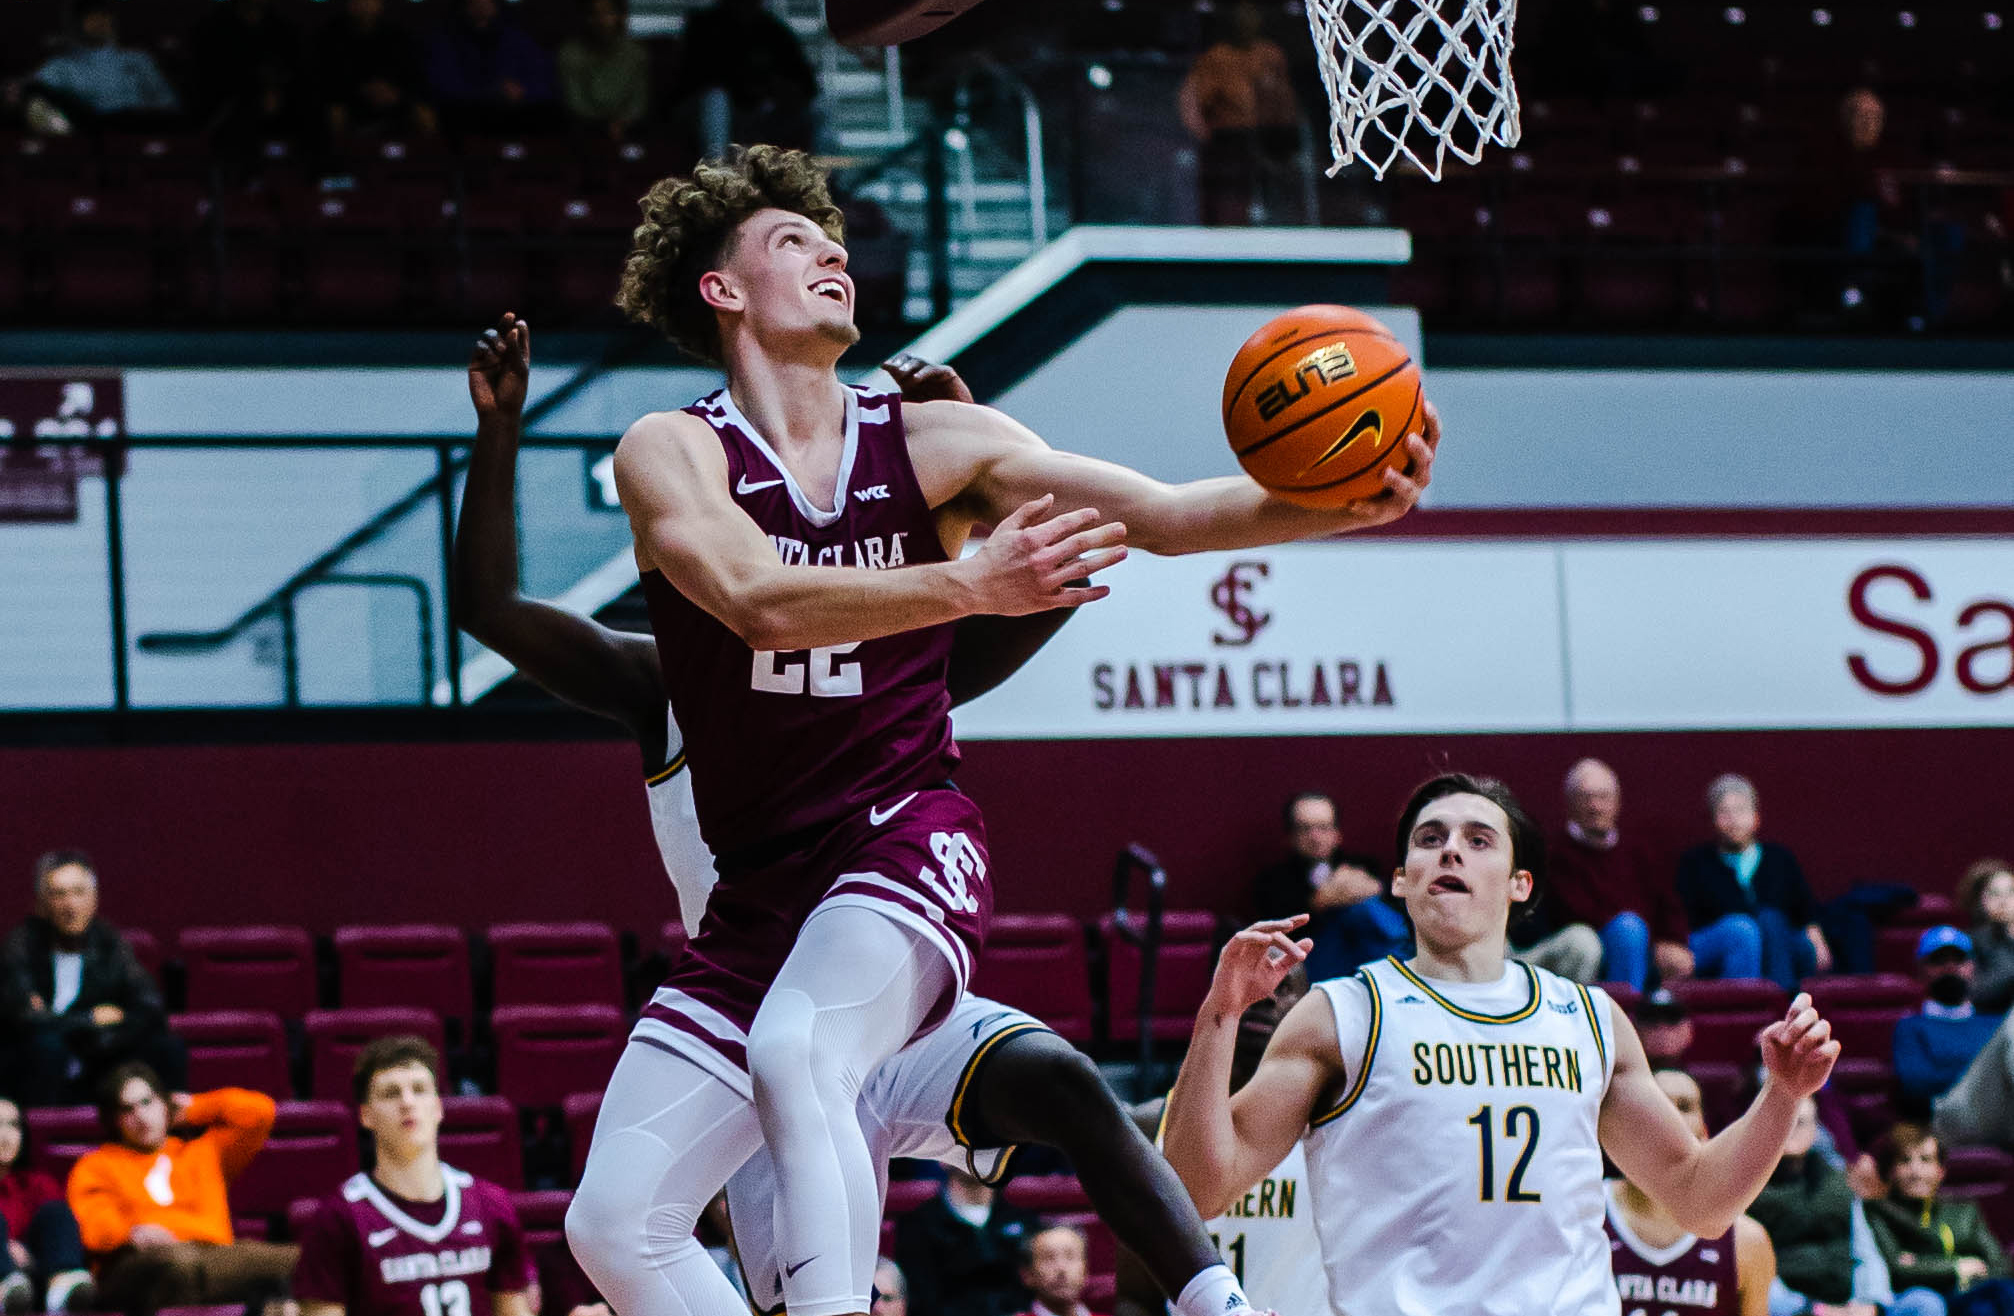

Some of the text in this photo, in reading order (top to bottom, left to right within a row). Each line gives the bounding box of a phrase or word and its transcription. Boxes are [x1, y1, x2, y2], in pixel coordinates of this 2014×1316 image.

[1256, 342, 1357, 421] ELITE
[1094, 663, 1395, 709] SANTA CLARA
[1413, 1041, 1582, 1094] SOUTHERN
[1467, 1104, 1541, 1203] 12
